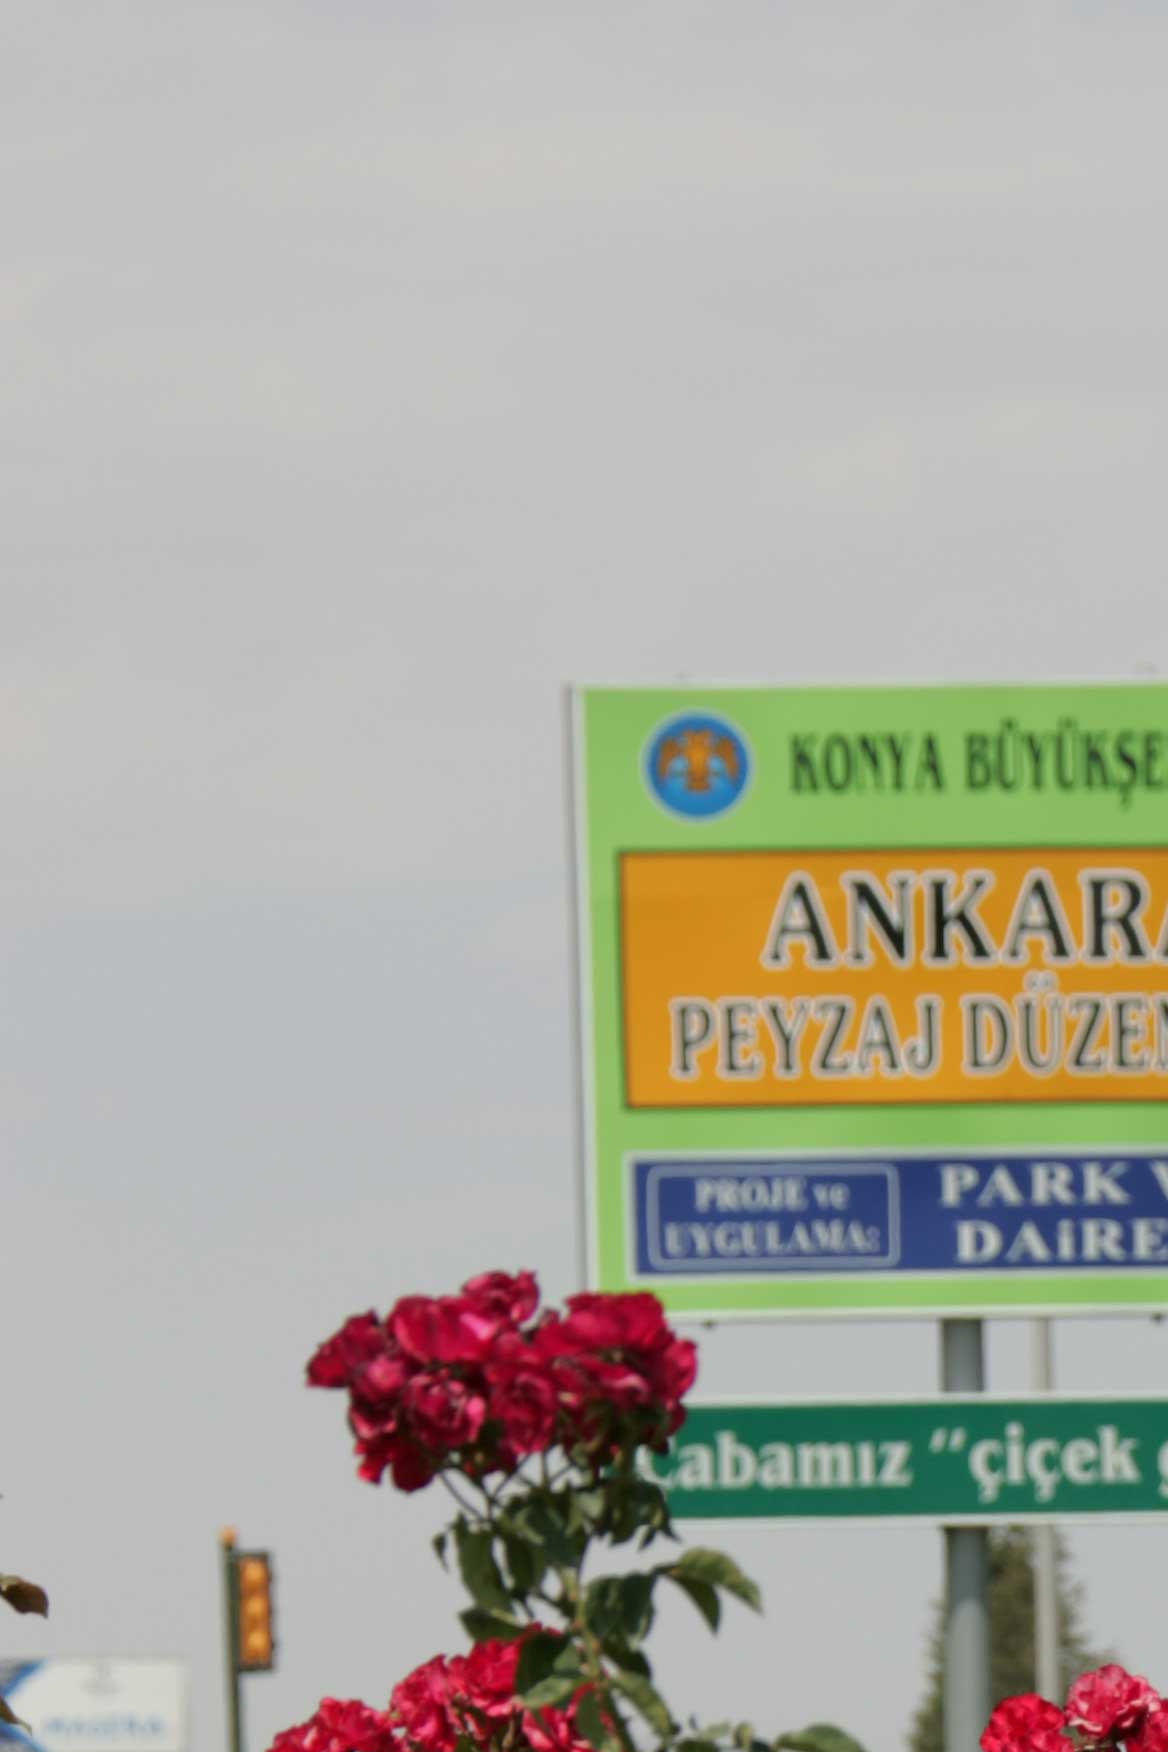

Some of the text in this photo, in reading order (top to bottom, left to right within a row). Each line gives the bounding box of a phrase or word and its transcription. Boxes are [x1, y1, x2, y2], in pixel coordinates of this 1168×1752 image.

[790, 731, 945, 795] KONYA
[669, 992, 943, 1081] PEYZAJ
[694, 1176, 808, 1213] PROJE
[938, 1160, 1131, 1208] PARK
